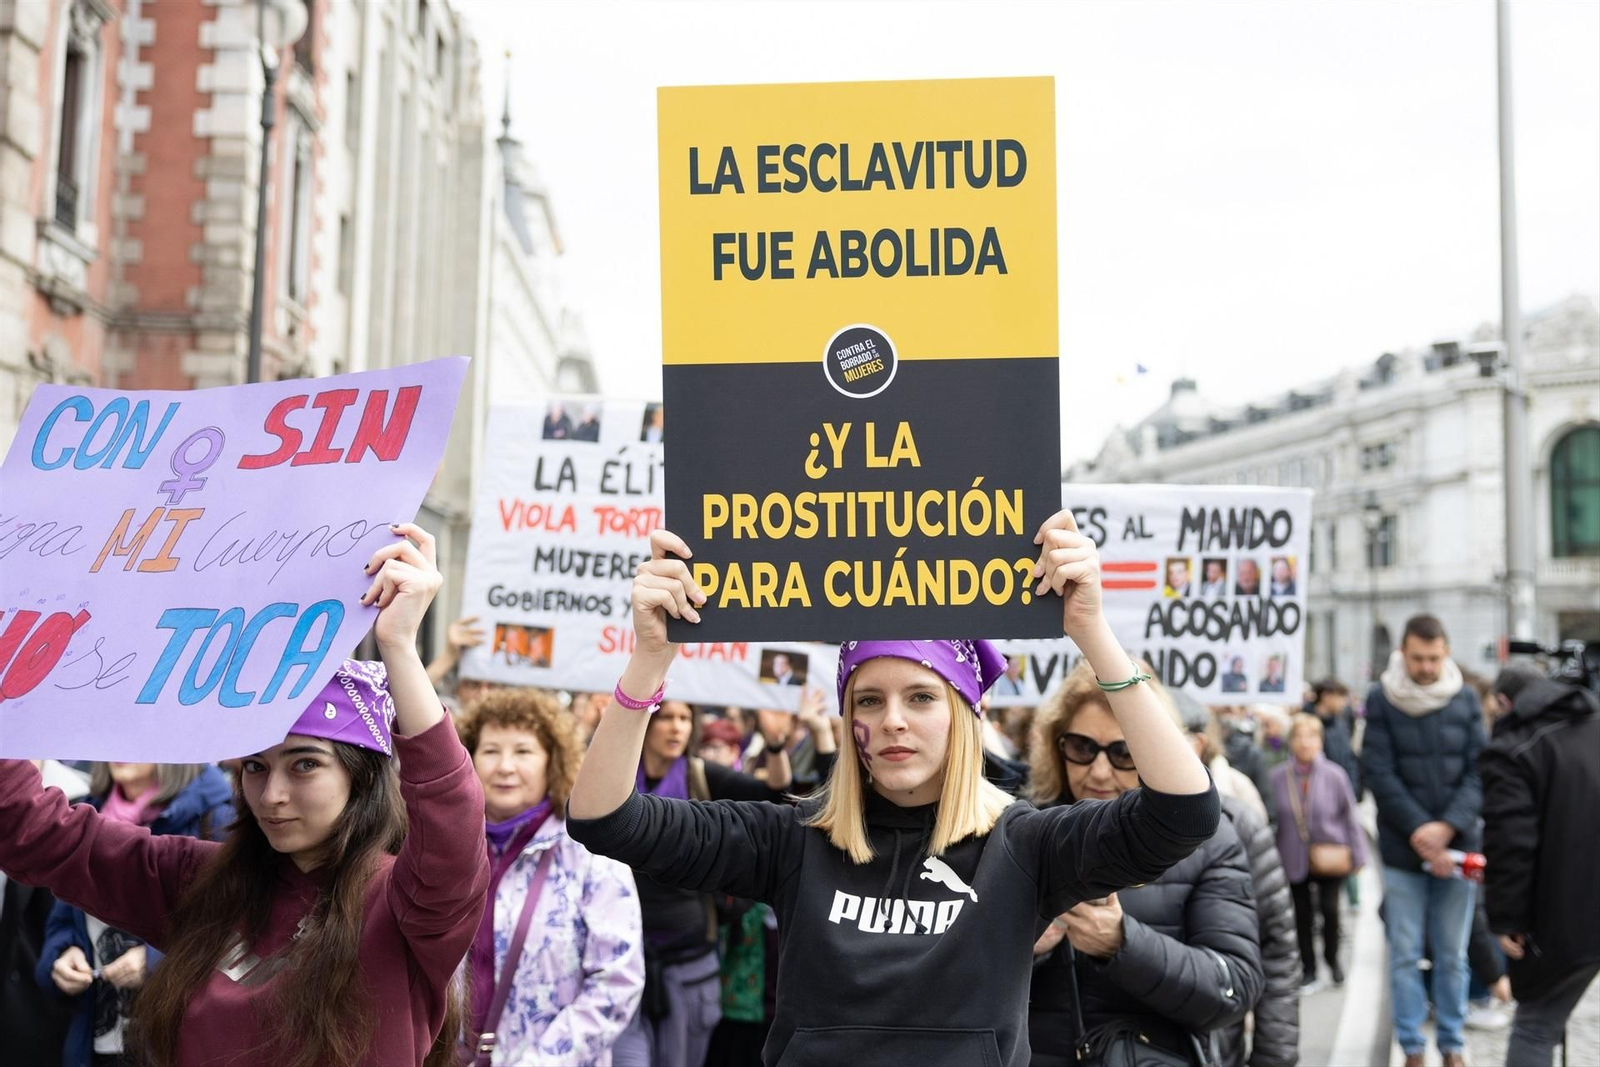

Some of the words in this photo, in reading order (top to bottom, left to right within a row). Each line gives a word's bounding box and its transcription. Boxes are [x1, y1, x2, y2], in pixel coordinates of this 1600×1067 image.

[689, 146, 745, 195] LA
[756, 138, 1027, 194] ESCLAVITUD
[712, 231, 795, 281] FUE
[806, 226, 1008, 279] ABOLIDA
[836, 342, 866, 361] CONTRA
[865, 339, 876, 349] EL
[840, 351, 873, 371] BORRADO
[844, 359, 884, 383] MUJERES
[31, 395, 181, 470] CON
[237, 385, 423, 469] SIN
[804, 422, 852, 480] ¿Y
[865, 421, 921, 468] LA
[533, 455, 577, 494] LA
[600, 446, 664, 495] ÉLI
[499, 499, 576, 533] VIOLA
[703, 476, 1024, 540] PROSTITUCIÓN
[1122, 513, 1154, 540] AL
[1178, 506, 1292, 551] MANDO
[89, 507, 205, 573] MI
[534, 546, 652, 580] MUJERE
[693, 560, 812, 609] PARA
[823, 547, 1036, 608] CUÁNDO?
[1145, 596, 1300, 643] ACOSANDO
[134, 598, 346, 708] TOCA
[828, 889, 965, 935] PUMA
